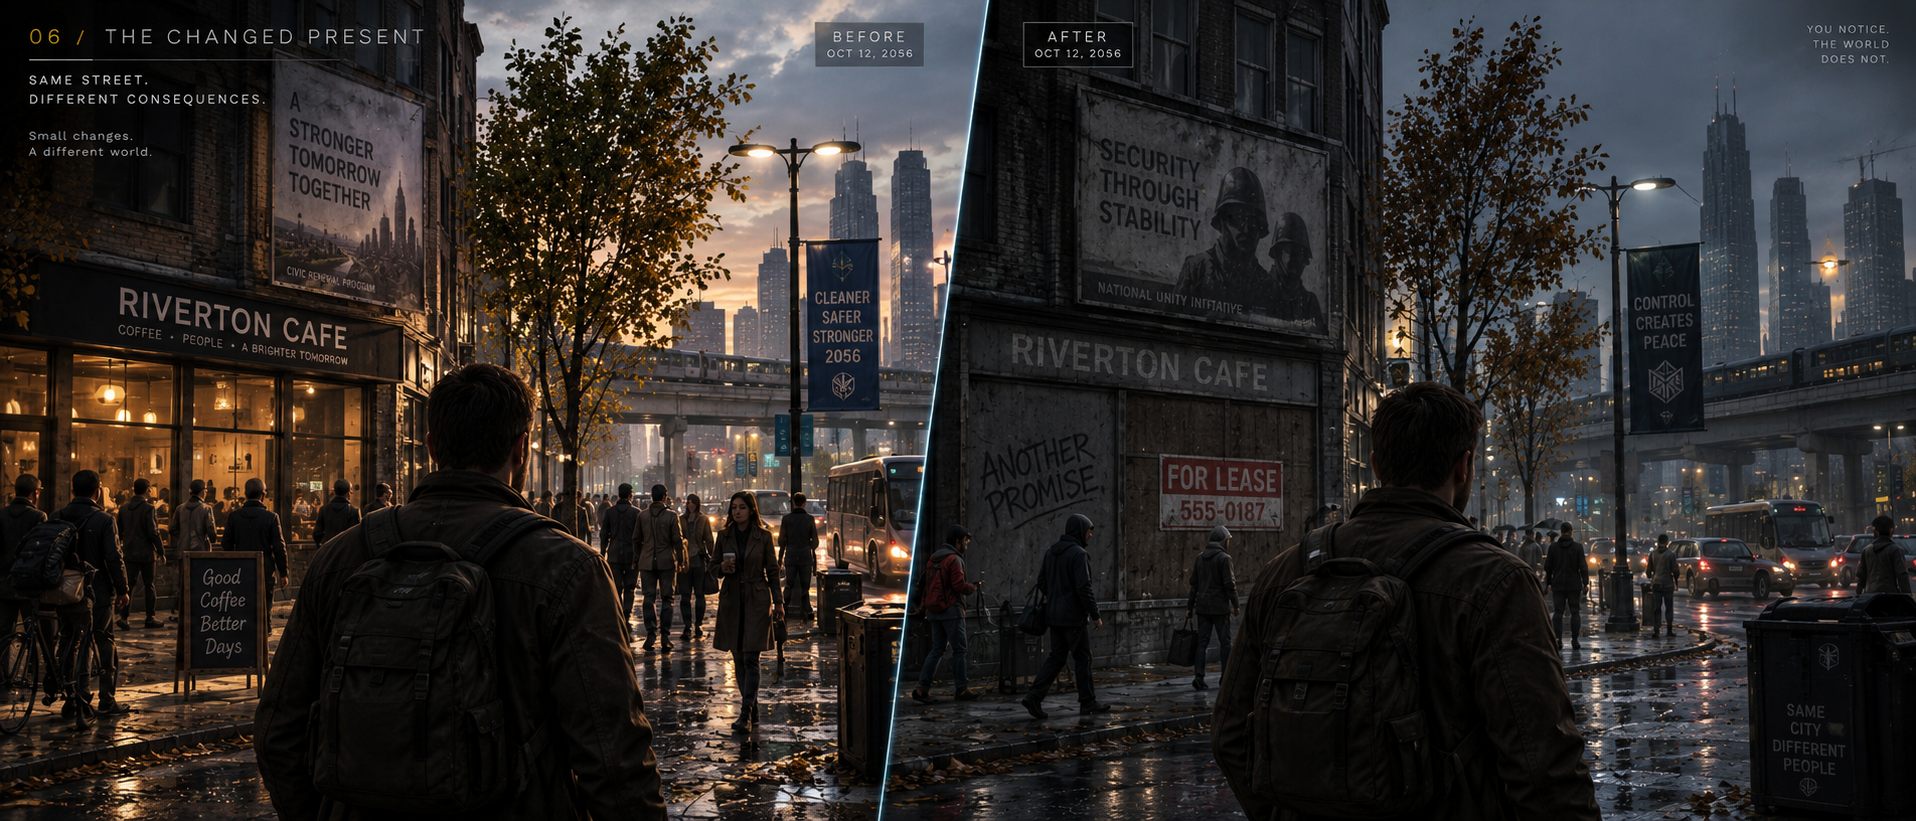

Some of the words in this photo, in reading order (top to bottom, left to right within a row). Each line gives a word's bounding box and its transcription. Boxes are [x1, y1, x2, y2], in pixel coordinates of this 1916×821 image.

[289, 91, 301, 113] A
[289, 117, 374, 161] STRONGER
[288, 143, 381, 188] TOMORROW
[1100, 137, 1200, 183] SECURITY
[288, 171, 371, 211] TOGETHER
[1099, 168, 1199, 212] THROUGH
[1099, 200, 1201, 241] STABILITY
[286, 265, 306, 279] CIVIC
[814, 290, 871, 305] CLEANER
[1098, 281, 1153, 301] NATIONAL
[1156, 291, 1188, 306] UNITY
[1633, 293, 1695, 312] CONTROL
[119, 286, 271, 338] RIVERTON
[283, 316, 348, 350] CAFE
[822, 309, 862, 325] SAFER
[1635, 312, 1694, 331] CREATES
[118, 324, 162, 340] COFFEE
[182, 333, 224, 349] PEOPLE
[241, 343, 249, 352] A
[251, 343, 297, 359] BRIGHTER
[299, 350, 349, 366] TOMORROW
[812, 328, 874, 344] STRONGER
[1643, 333, 1687, 350] PEACE
[825, 348, 861, 364] 2056
[1011, 333, 1180, 382] RIVERTON
[1193, 356, 1268, 392] CAFE
[980, 433, 1096, 491] ANOTHER
[1167, 463, 1209, 491] FOR
[1216, 466, 1277, 493] LEASE
[1180, 500, 1265, 522] 555-0187
[202, 567, 242, 588] Good
[200, 590, 246, 612] Coffee
[200, 615, 247, 632] Better
[205, 637, 243, 660] Days
[1786, 703, 1826, 719] SAME
[1790, 721, 1822, 737] CITY
[1772, 738, 1846, 758] DIFFERENT
[1783, 757, 1837, 776] PEOPLE
